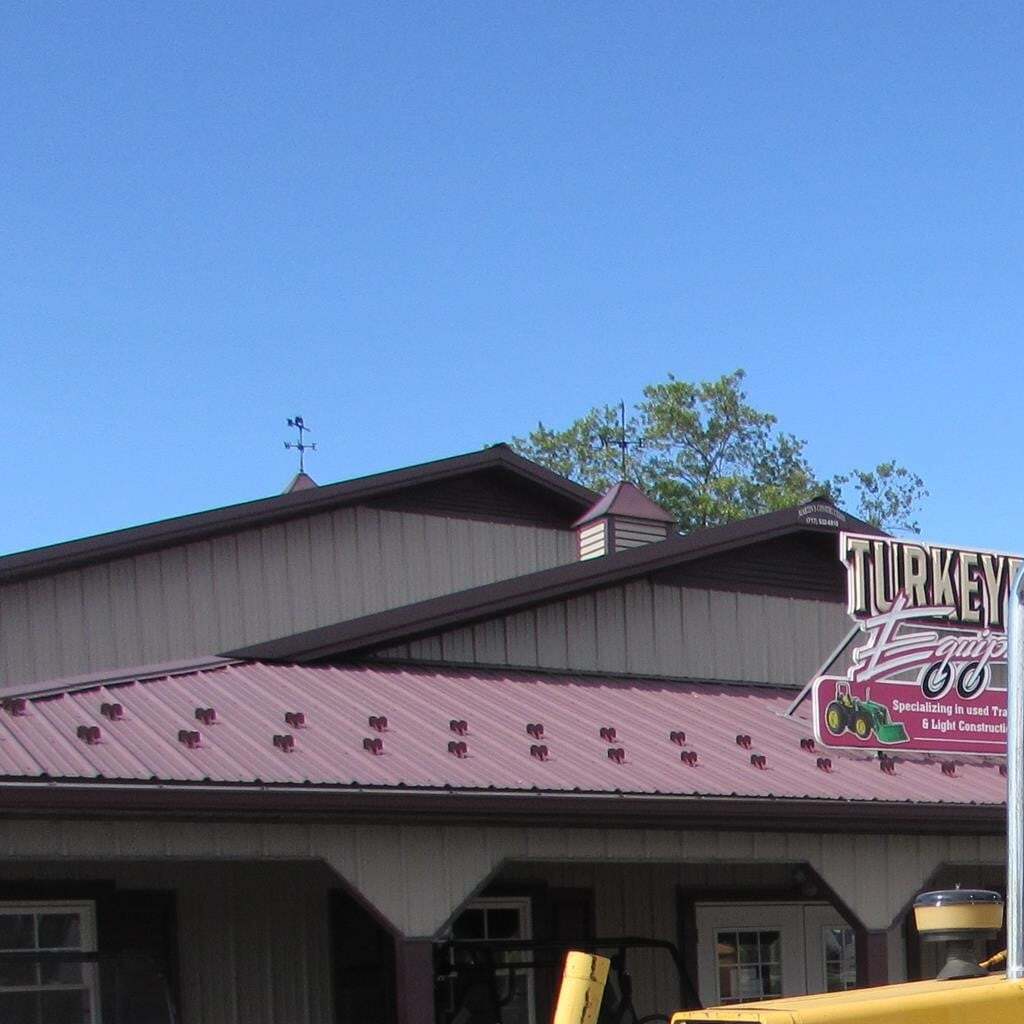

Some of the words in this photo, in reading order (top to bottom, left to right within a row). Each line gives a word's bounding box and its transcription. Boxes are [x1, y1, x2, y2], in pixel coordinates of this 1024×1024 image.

[892, 699, 953, 717] Specializing
[955, 703, 964, 715] in
[966, 704, 990, 717] used
[921, 718, 929, 730] &
[931, 718, 956, 733] Light
[958, 720, 1007, 733] Constructi
